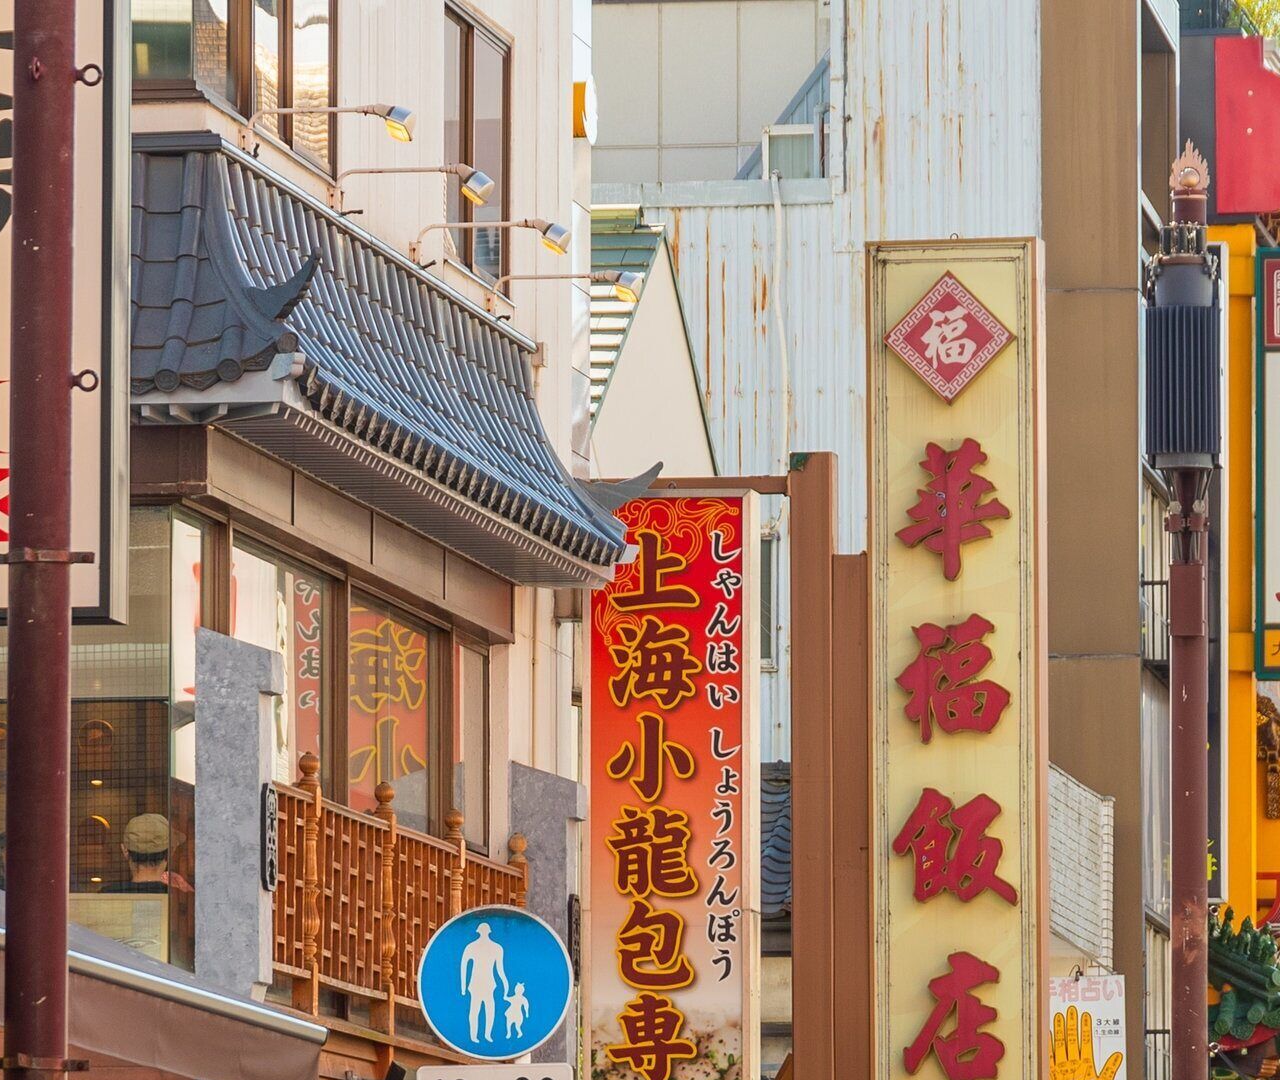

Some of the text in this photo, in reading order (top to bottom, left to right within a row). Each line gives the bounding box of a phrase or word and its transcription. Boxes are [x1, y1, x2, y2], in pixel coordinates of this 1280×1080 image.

[920, 305, 977, 369] 福
[704, 528, 743, 983] しゃんはい しょうろんぽう
